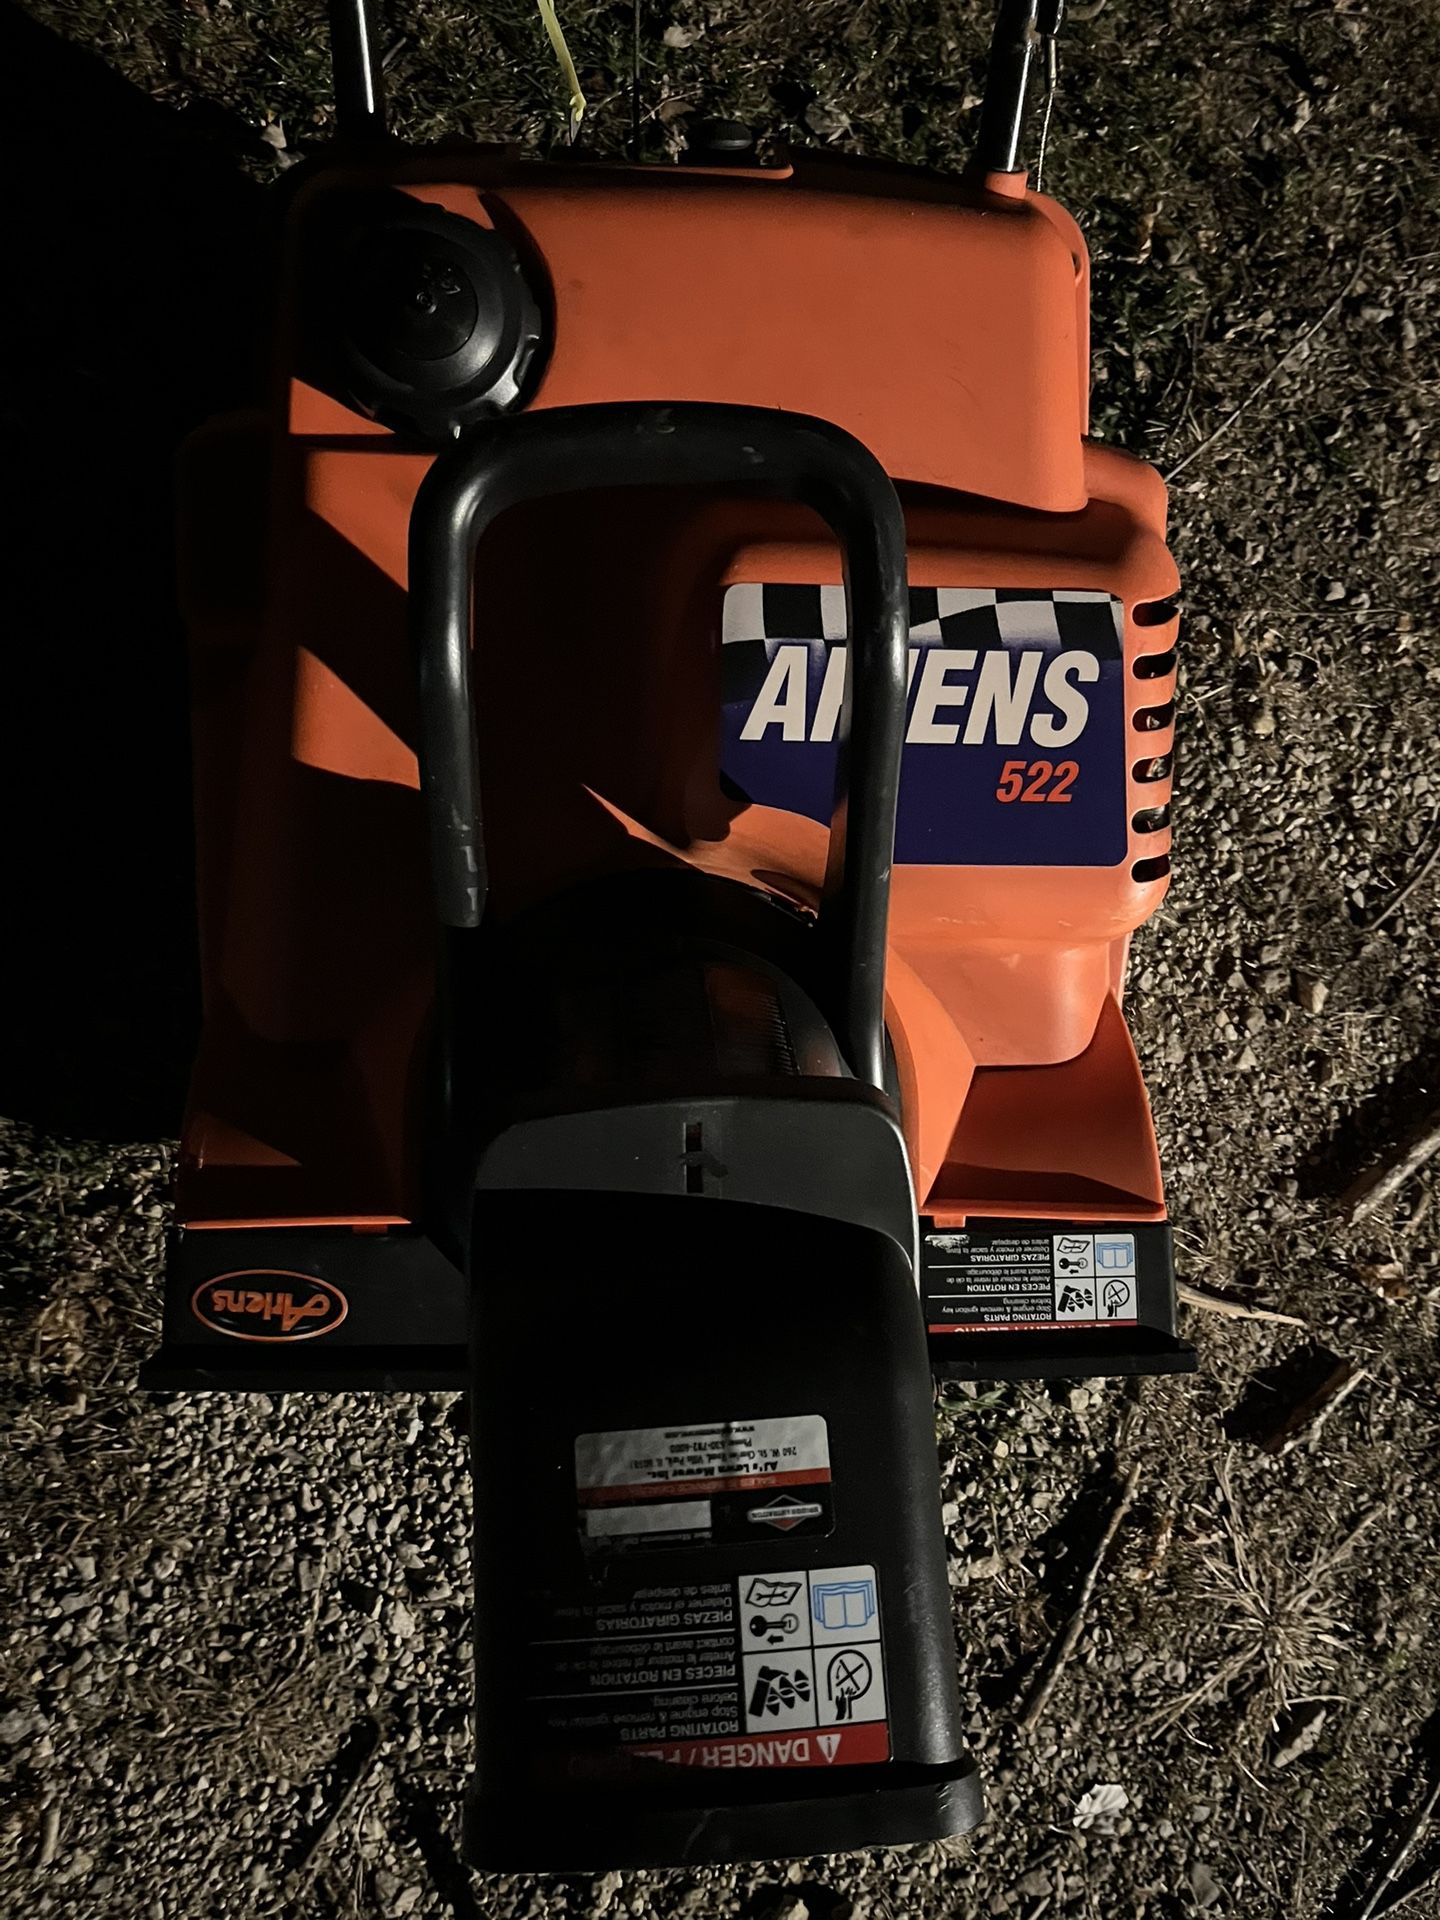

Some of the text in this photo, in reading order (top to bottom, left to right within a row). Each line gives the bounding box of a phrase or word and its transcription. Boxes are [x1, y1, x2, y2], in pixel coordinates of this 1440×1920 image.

[740, 645, 1100, 748] AENS
[995, 760, 1080, 803] 522
[1021, 1238, 1030, 1246] de
[997, 1246, 1015, 1254] motor
[970, 1253, 1050, 1262] PIEZAS GIRATORIAS
[966, 1283, 1051, 1292] PIECES EN ROTATION
[211, 1289, 331, 1332] Ariens
[942, 1306, 954, 1314] key
[955, 1304, 979, 1314] ignition
[1012, 1304, 1035, 1312] engine
[1036, 1304, 1052, 1312] Stop
[984, 1312, 1052, 1322] ROTATING PARTS
[758, 1450, 768, 1458] St.
[770, 1449, 780, 1457] W.
[647, 1461, 778, 1480] AJ's Lawn Mower Inc.
[682, 1586, 698, 1597] de
[699, 1583, 732, 1596] antes
[628, 1600, 638, 1614] y
[640, 1601, 672, 1612] motor
[674, 1600, 686, 1610] el
[688, 1596, 732, 1608] Detener
[595, 1610, 733, 1631] PIEZAS GIRATORIAS
[590, 1664, 736, 1686] PIECES EN ROTATION
[702, 1692, 738, 1704] before
[658, 1711, 668, 1724] &
[668, 1706, 709, 1721] engine
[711, 1705, 739, 1718] Stop
[619, 1720, 740, 1741] ROTATING PARTS
[702, 1737, 810, 1768] DANGER
